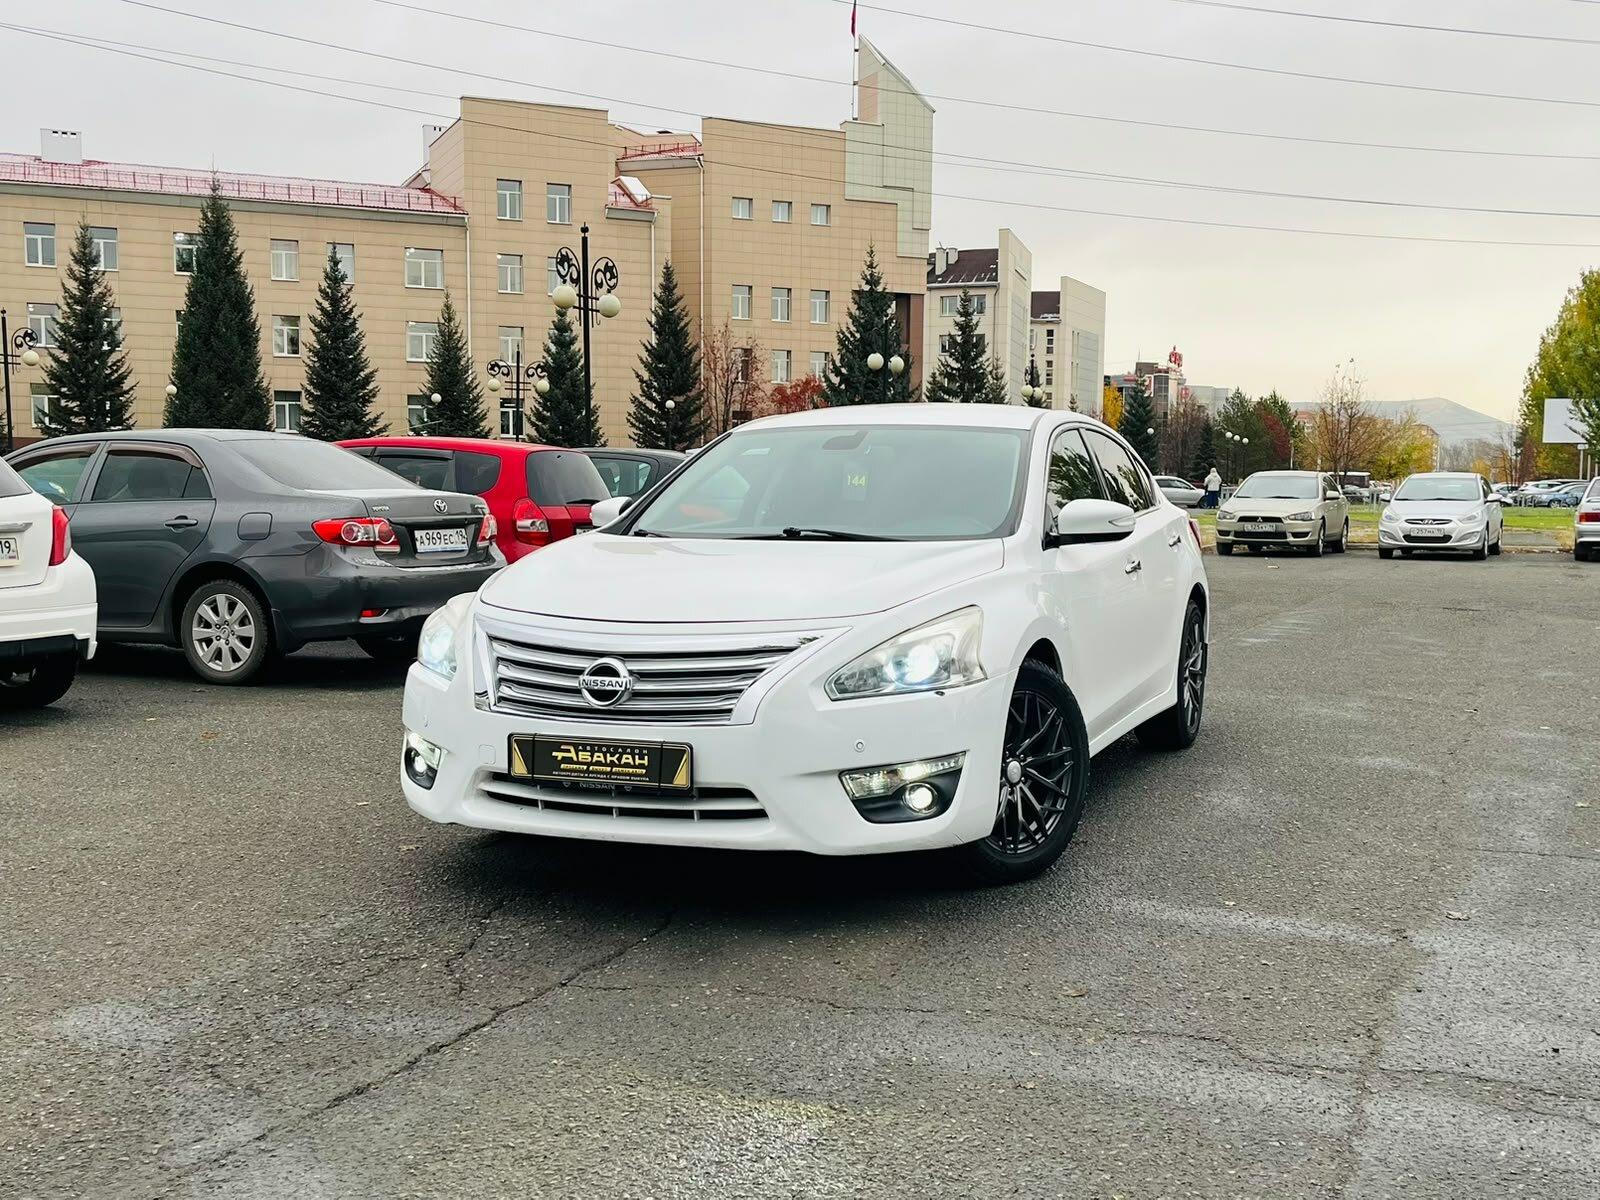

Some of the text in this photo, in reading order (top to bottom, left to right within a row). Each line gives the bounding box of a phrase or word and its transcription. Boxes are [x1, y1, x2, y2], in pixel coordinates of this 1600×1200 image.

[846, 474, 866, 487] 144
[420, 531, 454, 546] А969ЕС
[582, 679, 624, 688] NISSAN
[578, 745, 648, 754] АВТОСАЛОН
[552, 744, 649, 767] АБАКАН
[580, 782, 616, 790] NISSAN
